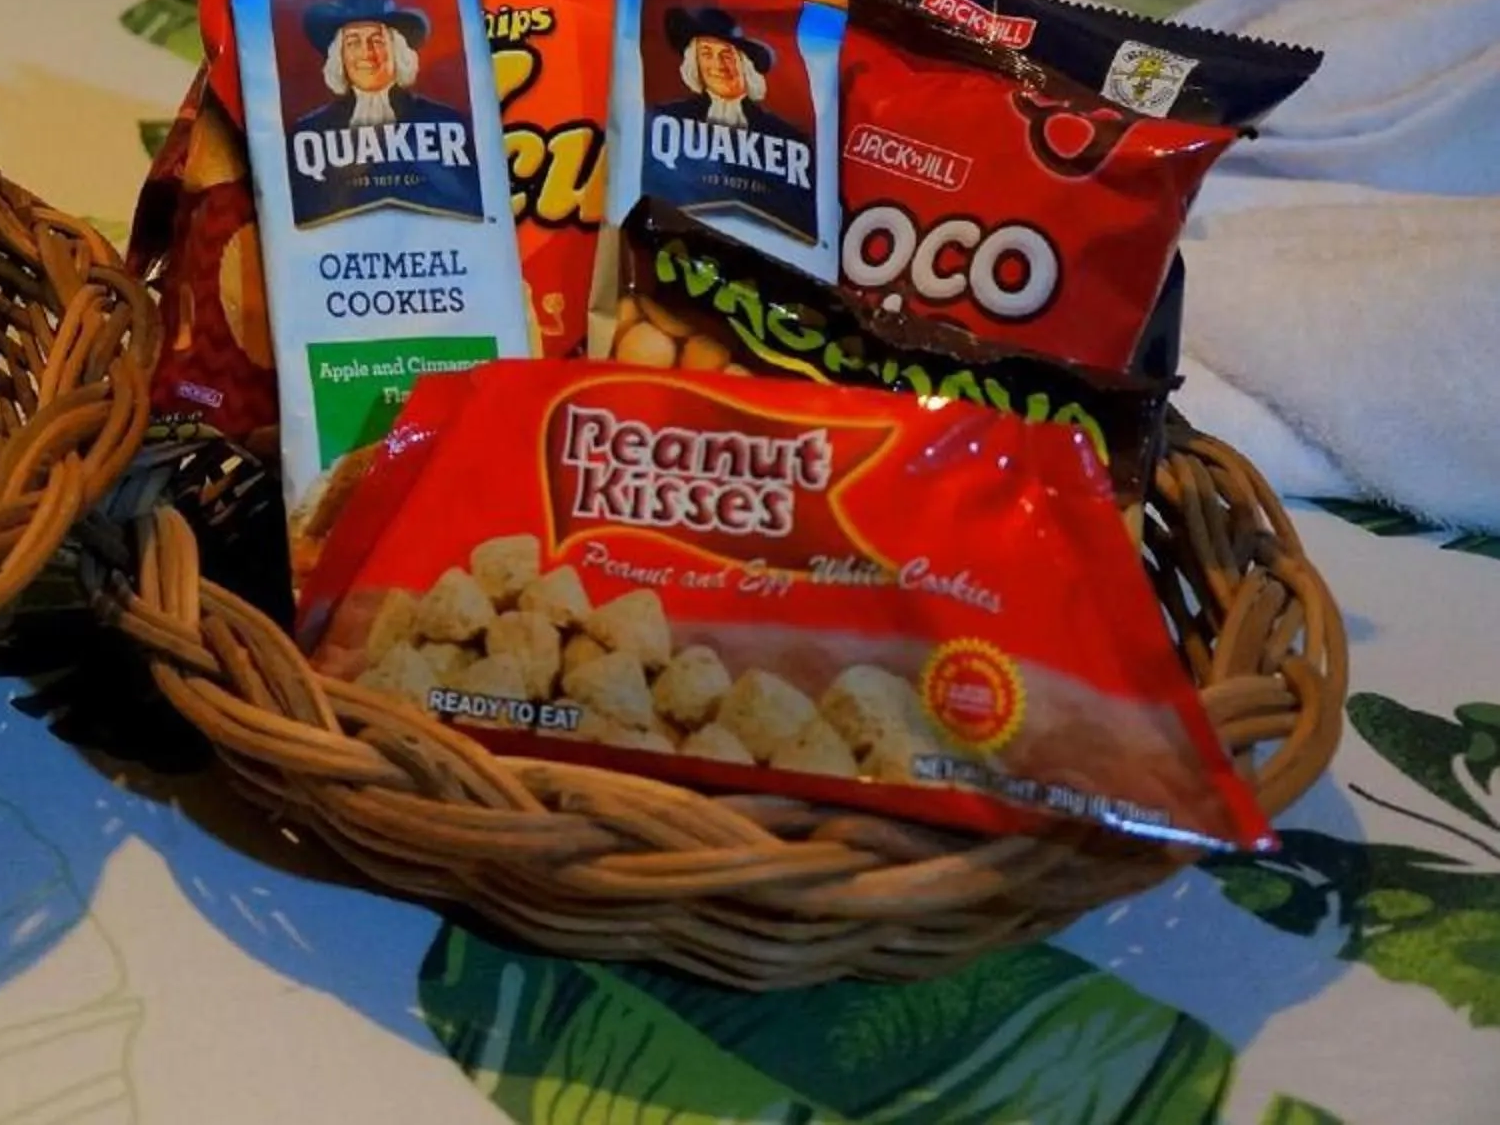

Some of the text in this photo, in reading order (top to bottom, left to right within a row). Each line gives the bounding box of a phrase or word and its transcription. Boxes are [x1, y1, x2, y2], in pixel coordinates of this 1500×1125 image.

[293, 121, 471, 181] QUAKER
[651, 115, 812, 190] QUAKER
[319, 249, 468, 280] OATMEAL
[326, 287, 465, 318] COOKIES
[320, 358, 369, 383] Apple
[372, 356, 404, 376] and
[562, 402, 833, 490] Peanut
[572, 460, 796, 538] Kisses
[582, 541, 675, 586] Peanut
[681, 568, 727, 589] and
[739, 559, 794, 597] Egg
[899, 556, 1002, 615] Cookies
[429, 689, 580, 730] READY TO EAT
